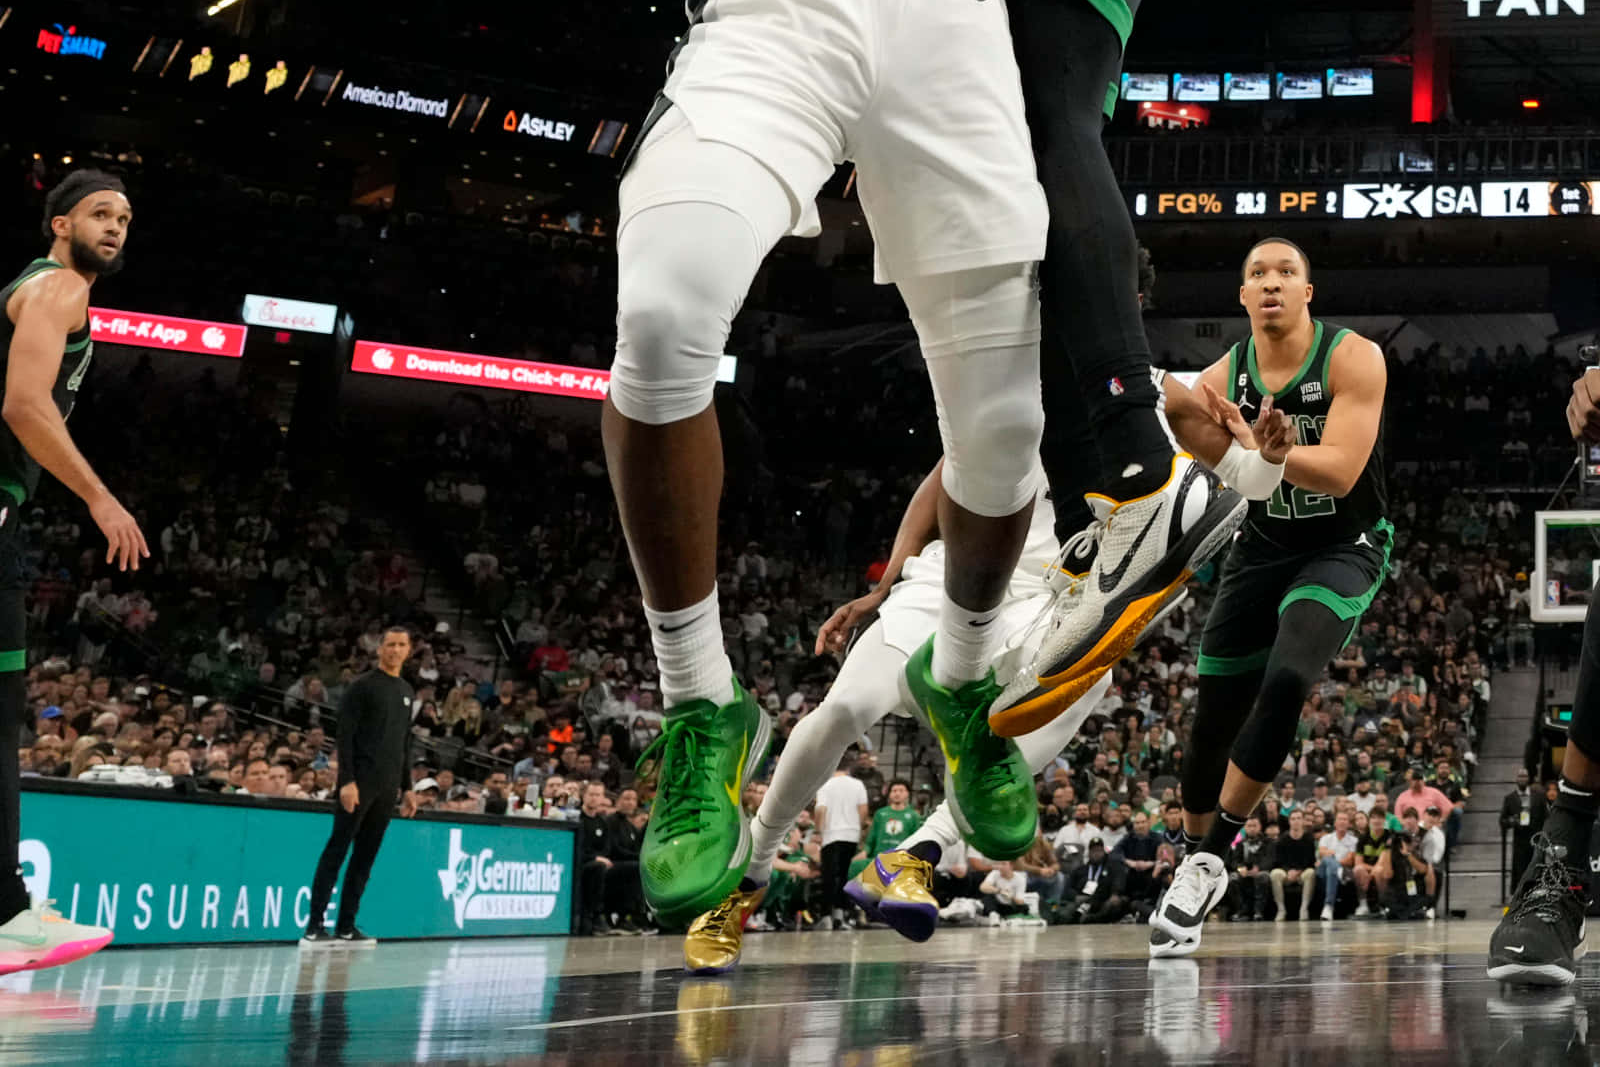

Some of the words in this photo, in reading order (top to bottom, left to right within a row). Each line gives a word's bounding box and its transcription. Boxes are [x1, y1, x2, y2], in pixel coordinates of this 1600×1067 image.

[342, 82, 394, 109] Americus
[395, 90, 448, 118] Diamond
[517, 112, 575, 142] ASHLEY
[1158, 193, 1222, 214] FG%
[1279, 191, 1317, 213] PF
[1435, 186, 1478, 214] SA
[1504, 188, 1529, 213] 14
[90, 315, 149, 338] k-fil-A
[151, 323, 187, 344] App
[406, 354, 481, 377] Download
[485, 361, 510, 381] the
[1239, 374, 1247, 387] 6
[1300, 381, 1321, 394] VISTA
[1301, 392, 1323, 403] PRINT
[477, 848, 560, 892] Germania
[480, 898, 545, 915] INSURANCE
